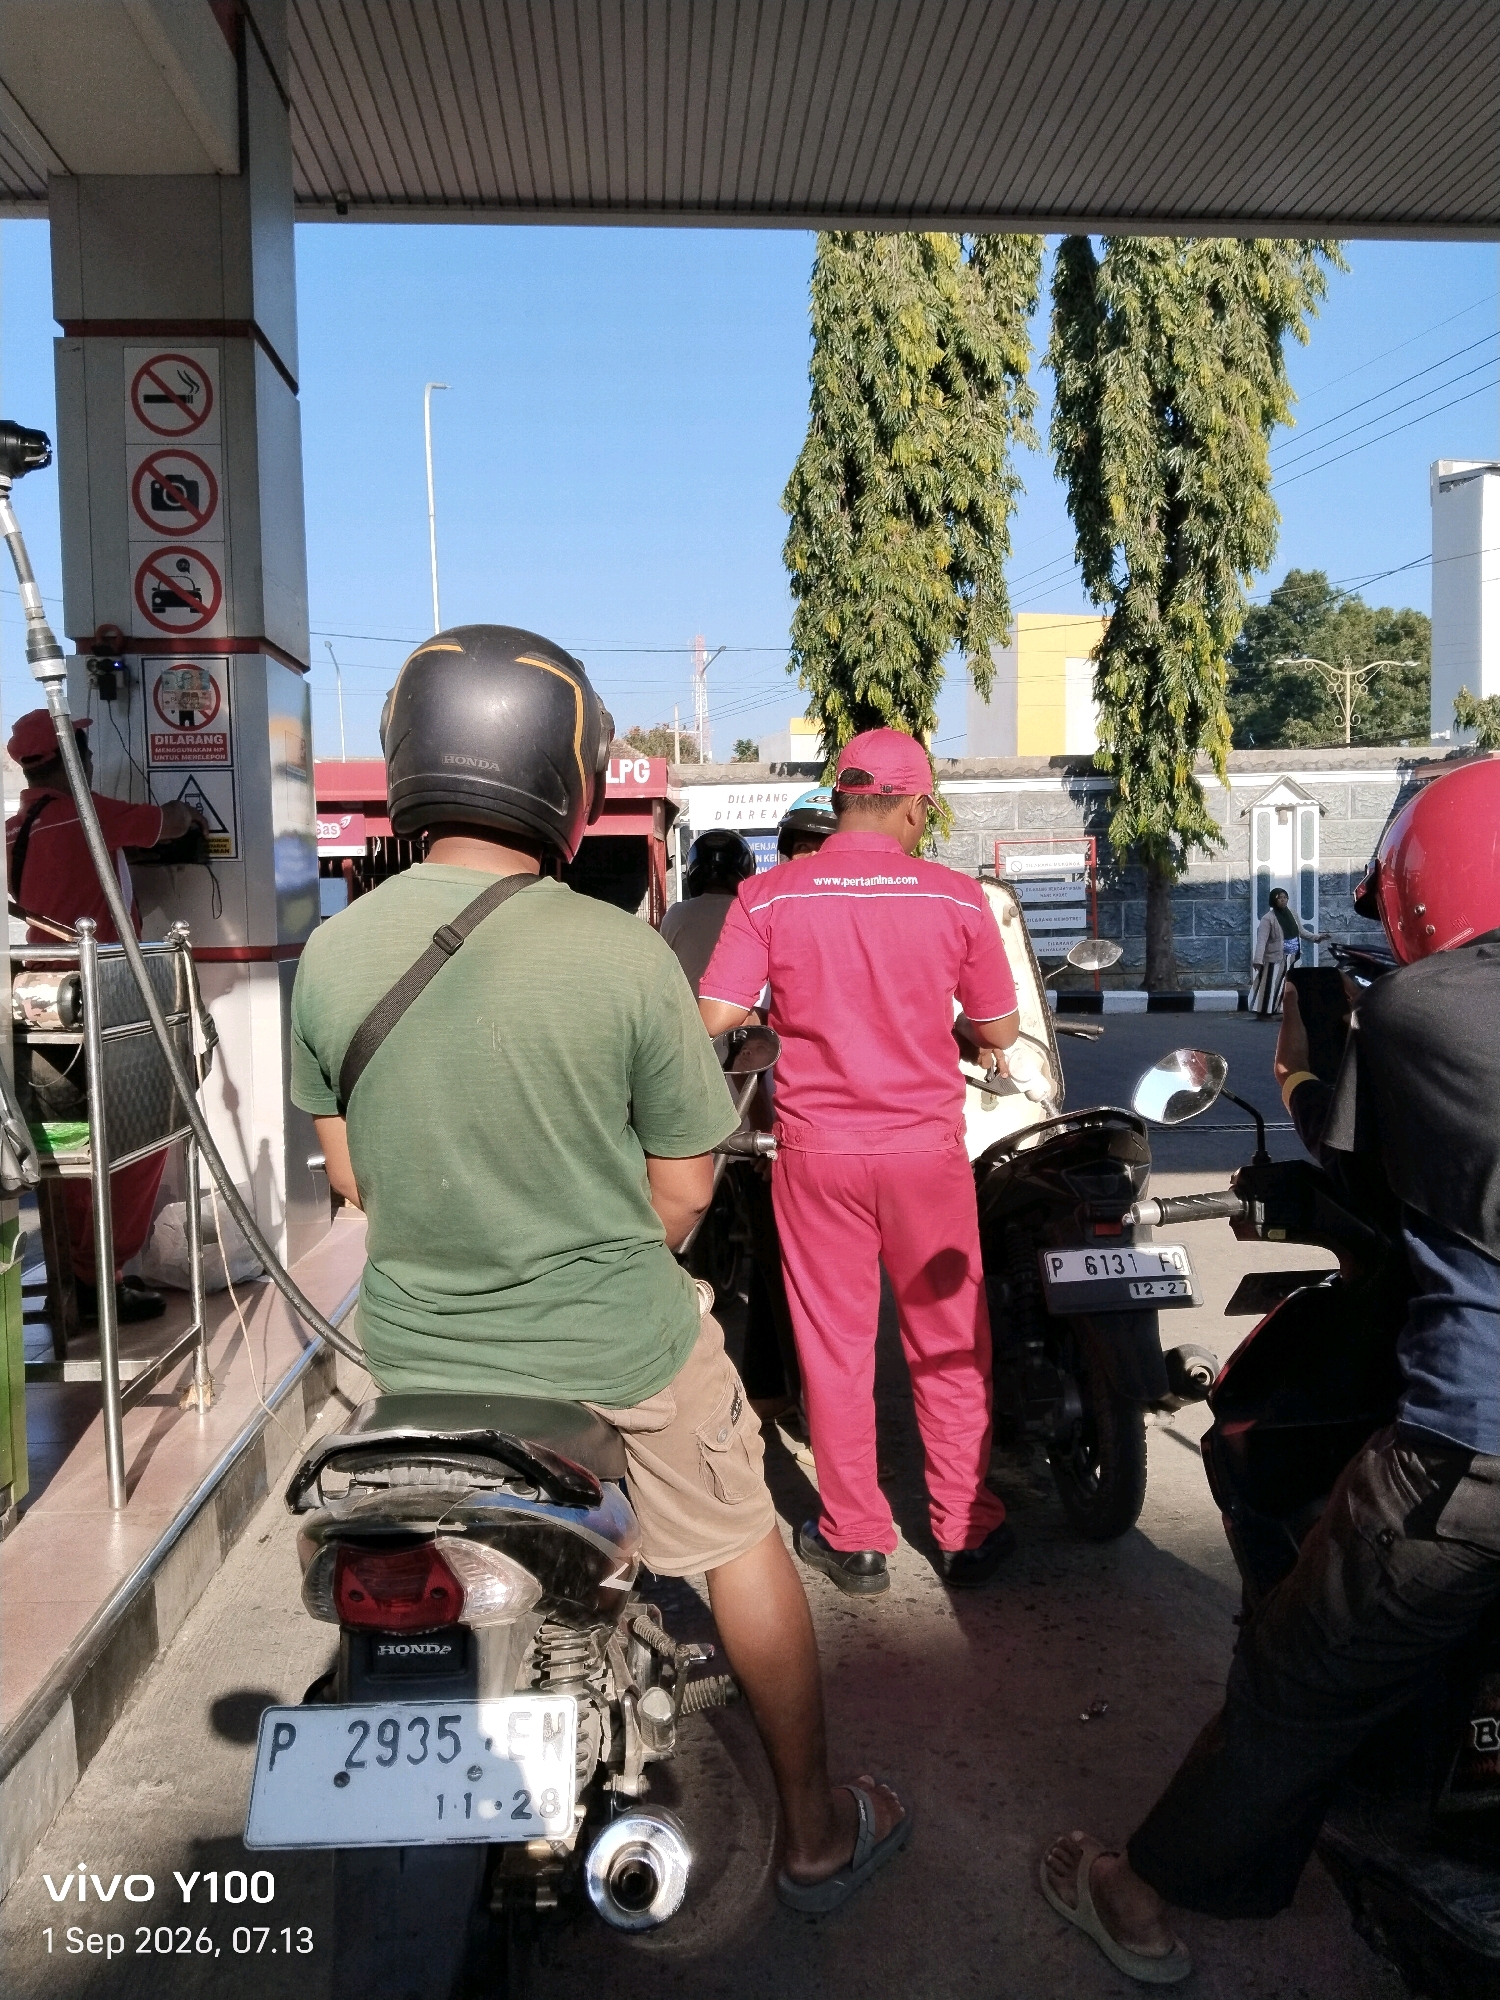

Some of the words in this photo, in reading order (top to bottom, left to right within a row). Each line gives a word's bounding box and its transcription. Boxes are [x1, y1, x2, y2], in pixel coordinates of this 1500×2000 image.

[154, 735, 224, 745] DILARANG
[443, 755, 501, 772] HONDA
[606, 758, 650, 784] LPG
[727, 793, 789, 804] DILARANG
[813, 874, 919, 888] www.pertamina.com
[1051, 1257, 1064, 1278] P
[1084, 1253, 1139, 1276] 6131
[378, 1643, 452, 1657] HONDA
[269, 1722, 297, 1772] P
[345, 1714, 462, 1768] 2935
